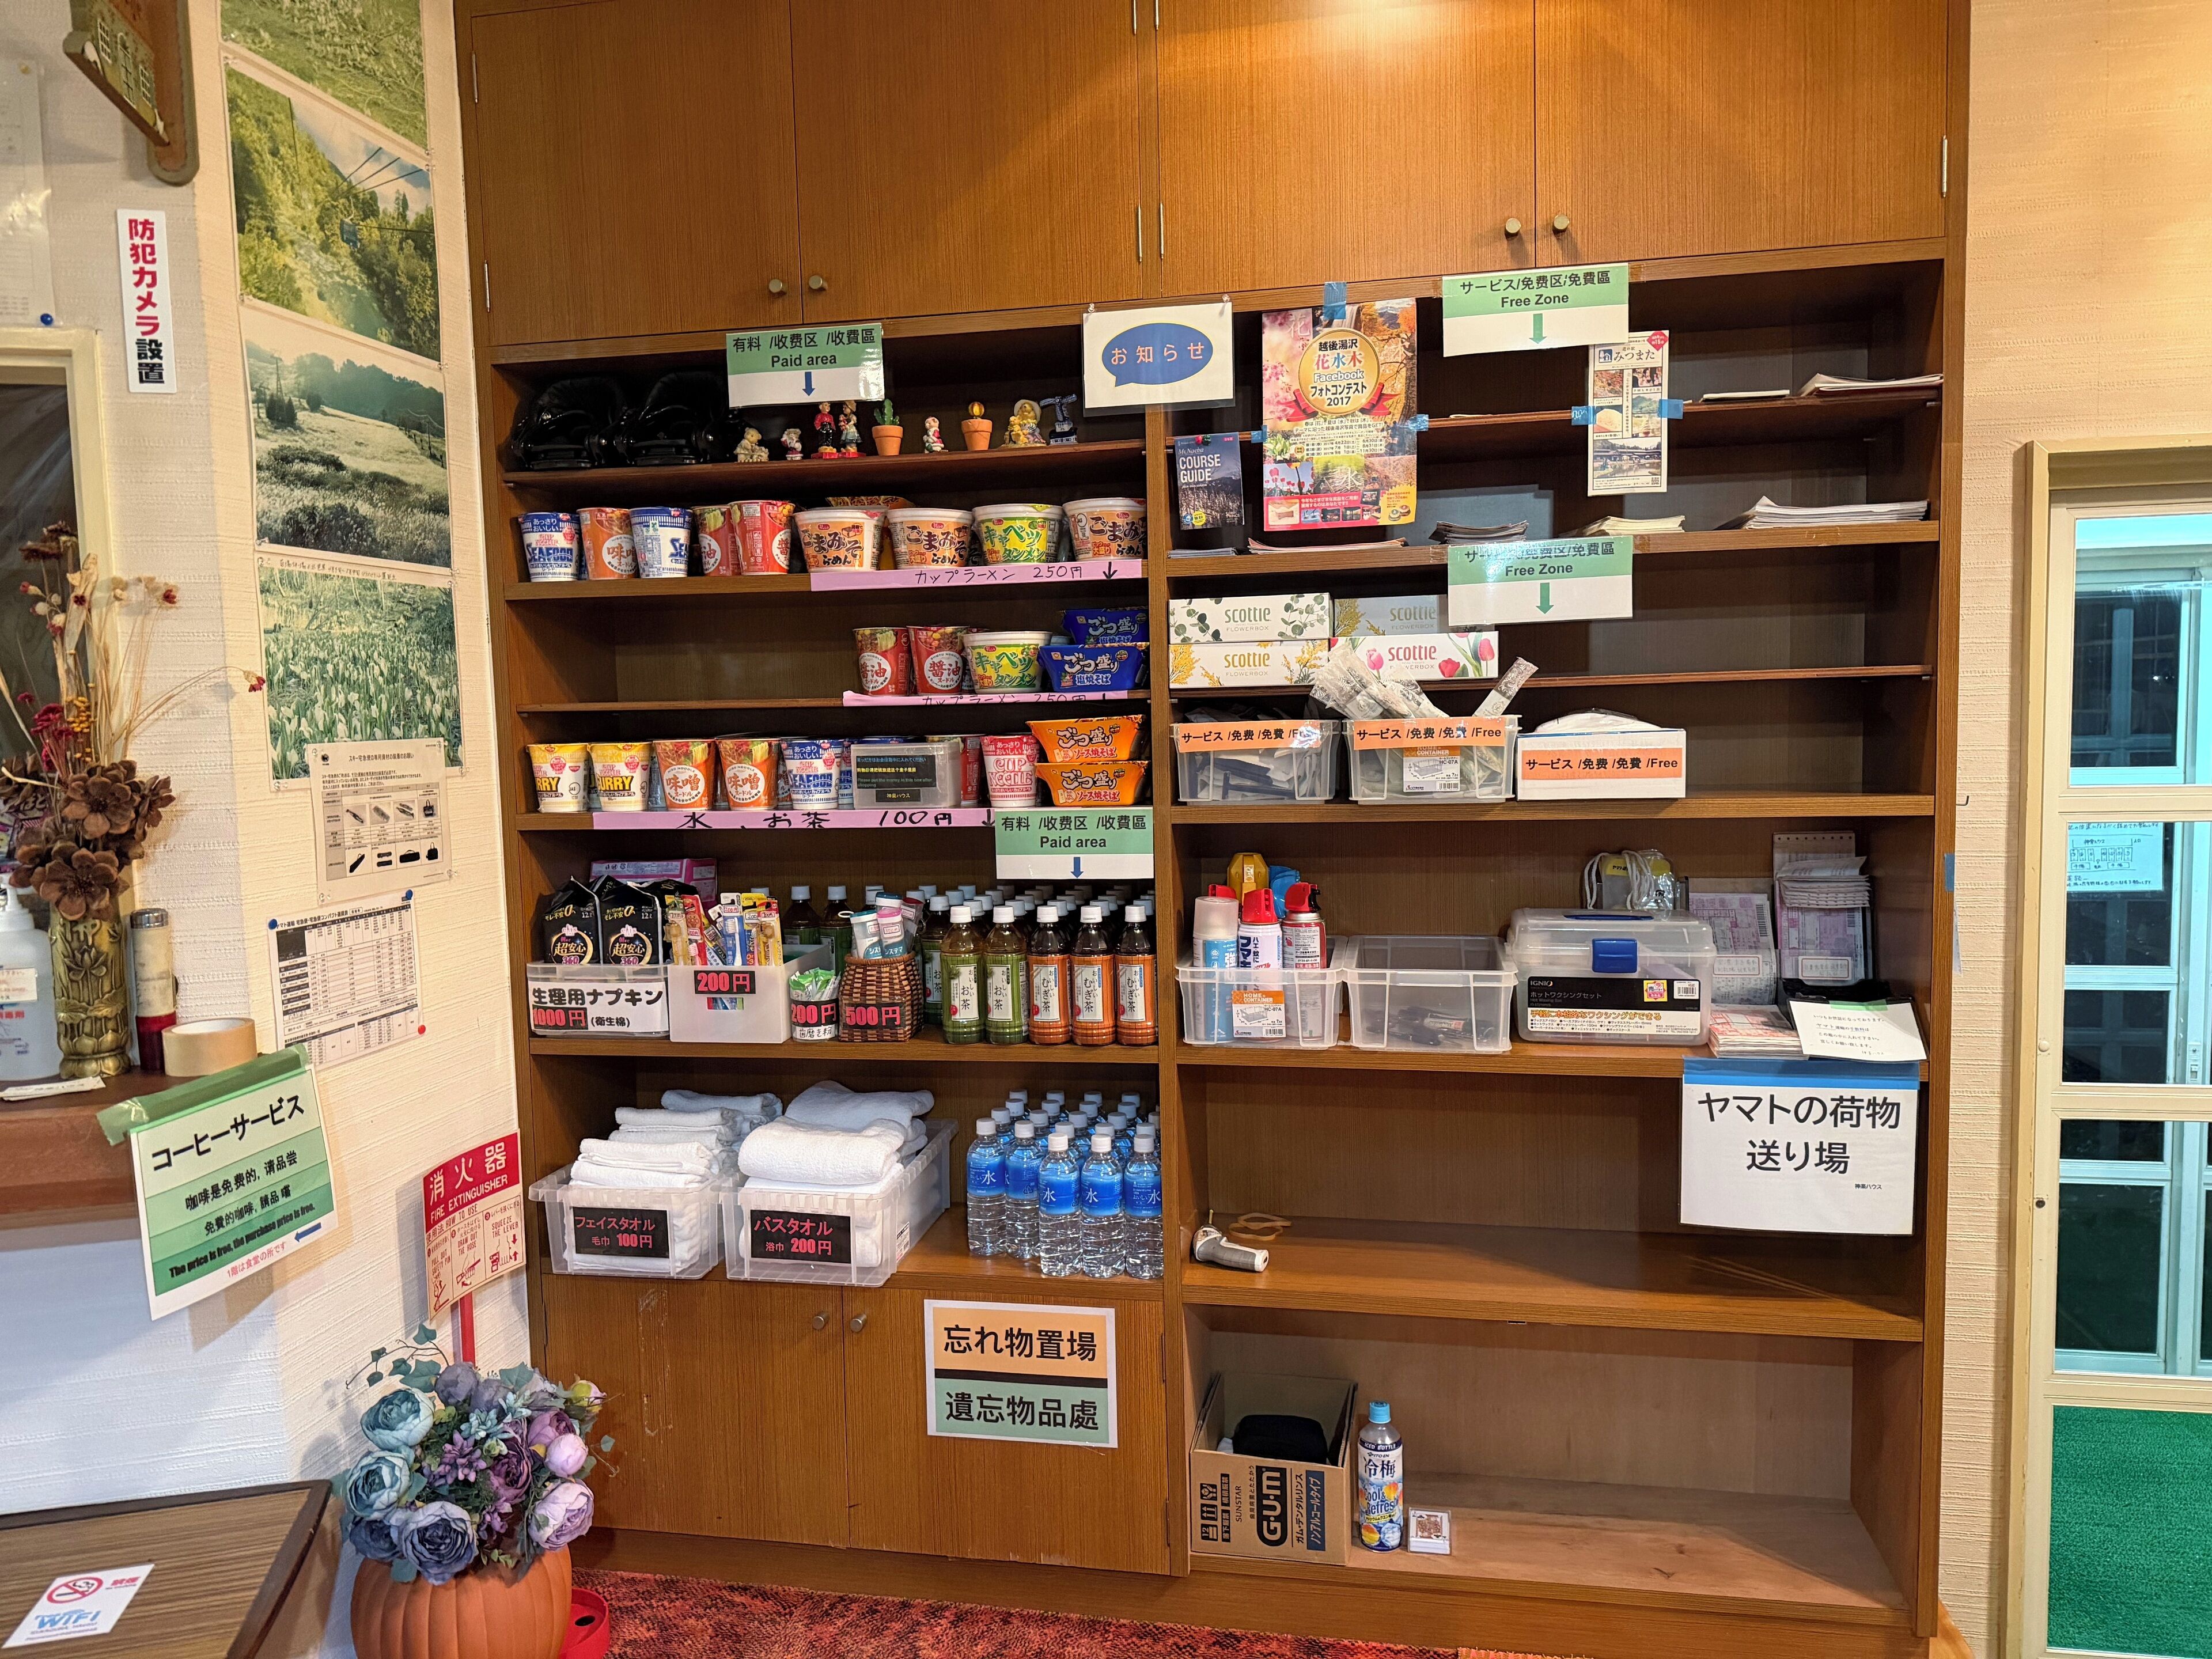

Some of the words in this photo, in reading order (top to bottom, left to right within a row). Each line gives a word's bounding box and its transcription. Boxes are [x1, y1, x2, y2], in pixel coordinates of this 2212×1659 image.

[128, 219, 165, 384] 防犯カメラ設置
[1501, 296, 1531, 308] Free
[1535, 293, 1569, 305] Zone
[732, 337, 761, 352] 有料
[1319, 339, 1358, 351] 越後湯沢
[771, 352, 802, 368] Paid
[806, 353, 837, 366] area
[1111, 342, 1205, 366] お知らせ
[1314, 351, 1362, 370] 花水木
[1614, 350, 1655, 362] みつまた
[1313, 369, 1365, 383] Facebook
[1310, 381, 1368, 397] フォトコンテスト
[1326, 396, 1351, 407] 2017
[1179, 454, 1221, 469] COURSE
[1180, 469, 1212, 483] GUIDE
[906, 525, 967, 559] ごまみそ
[985, 525, 1042, 547] キャベツ
[527, 543, 573, 562] SEAFOOD
[1002, 547, 1046, 560] タンメン
[915, 569, 1016, 585] カップラーメン
[1033, 566, 1083, 579] 250円
[1505, 565, 1535, 577] Free
[1539, 563, 1573, 575] Zone
[1225, 608, 1271, 623] scottie
[1389, 607, 1437, 621] scottie
[1088, 616, 1139, 636] ごつ盛り
[1226, 624, 1269, 632] FLOWERBOX
[1224, 653, 1271, 668] scottie
[1388, 645, 1437, 661] scottie
[929, 660, 960, 677] 醤油
[975, 652, 1033, 673] キャベツ
[1063, 652, 1119, 674] ごつ盛り
[994, 673, 1037, 687] タンメン
[1056, 726, 1112, 748] ごつ盛り
[1182, 731, 1223, 743] サービス
[1357, 729, 1402, 741] サービス
[1472, 727, 1501, 737] /Free
[1074, 747, 1117, 758] ソース焼そば
[994, 758, 1027, 772] CUP
[1526, 758, 1573, 770] サービス
[1646, 758, 1678, 768] /Free
[665, 774, 700, 791] 味噌
[726, 773, 760, 790] 味噌
[788, 770, 832, 788] SEAFOOD
[988, 771, 1033, 786] NOODLE
[1061, 769, 1117, 790] ごつ盛り
[1077, 789, 1120, 802] ソース焼そば
[879, 810, 952, 826] 100円
[1001, 816, 1030, 831] 有料
[1040, 836, 1071, 849] Paid
[1077, 837, 1107, 849] area
[554, 942, 586, 956] 超安心
[611, 943, 645, 957] 超安心
[562, 956, 579, 965] 360
[620, 957, 639, 965] 360
[696, 972, 750, 992] 200円
[532, 988, 663, 1006] 生理用ナプキン
[961, 986, 970, 1010] お茶
[994, 987, 1003, 1010] お茶
[1042, 978, 1051, 1012] むぎ茶
[1084, 979, 1094, 1013] むぎ茶
[1127, 978, 1136, 1012] むぎ茶
[533, 1007, 586, 1028] 1000円
[791, 1003, 836, 1024] 200円
[846, 1006, 900, 1025] 500円
[800, 1027, 832, 1037] 歯磨き粉
[1698, 1092, 1900, 1129] ヤマトの荷物
[151, 1094, 304, 1172] コーヒーサービス
[1747, 1139, 1850, 1174] 送り場
[430, 1142, 507, 1206] 消火器
[982, 1171, 997, 1185] 水
[431, 1204, 445, 1224] FIRE
[449, 1174, 507, 1211] EXTINGUISHER
[1043, 1188, 1056, 1203] 水
[1085, 1188, 1099, 1204] 水
[1147, 1190, 1161, 1205] 水
[446, 1217, 456, 1229] HOW
[459, 1210, 465, 1219] TO
[468, 1204, 478, 1215] USE
[492, 1215, 512, 1230] SQUEEZE
[575, 1216, 656, 1232] フェイスタオル
[493, 1230, 501, 1238] THE
[503, 1221, 518, 1233] LEVER
[754, 1218, 833, 1236] バスタオル
[592, 1236, 611, 1247] 毛巾
[617, 1233, 653, 1249] 100円
[766, 1241, 785, 1252] 浴巾
[791, 1237, 831, 1255] 200円
[944, 1324, 1097, 1361] 忘れ物置場
[945, 1392, 1099, 1430] 遺忘物品處
[1363, 1457, 1396, 1478] 冷梅
[1364, 1488, 1381, 1501] Cool
[1296, 1474, 1304, 1544] ガム・デンタルリンス
[1309, 1477, 1321, 1544] ノンアルコールタイプ
[1202, 1528, 1209, 1536] 12
